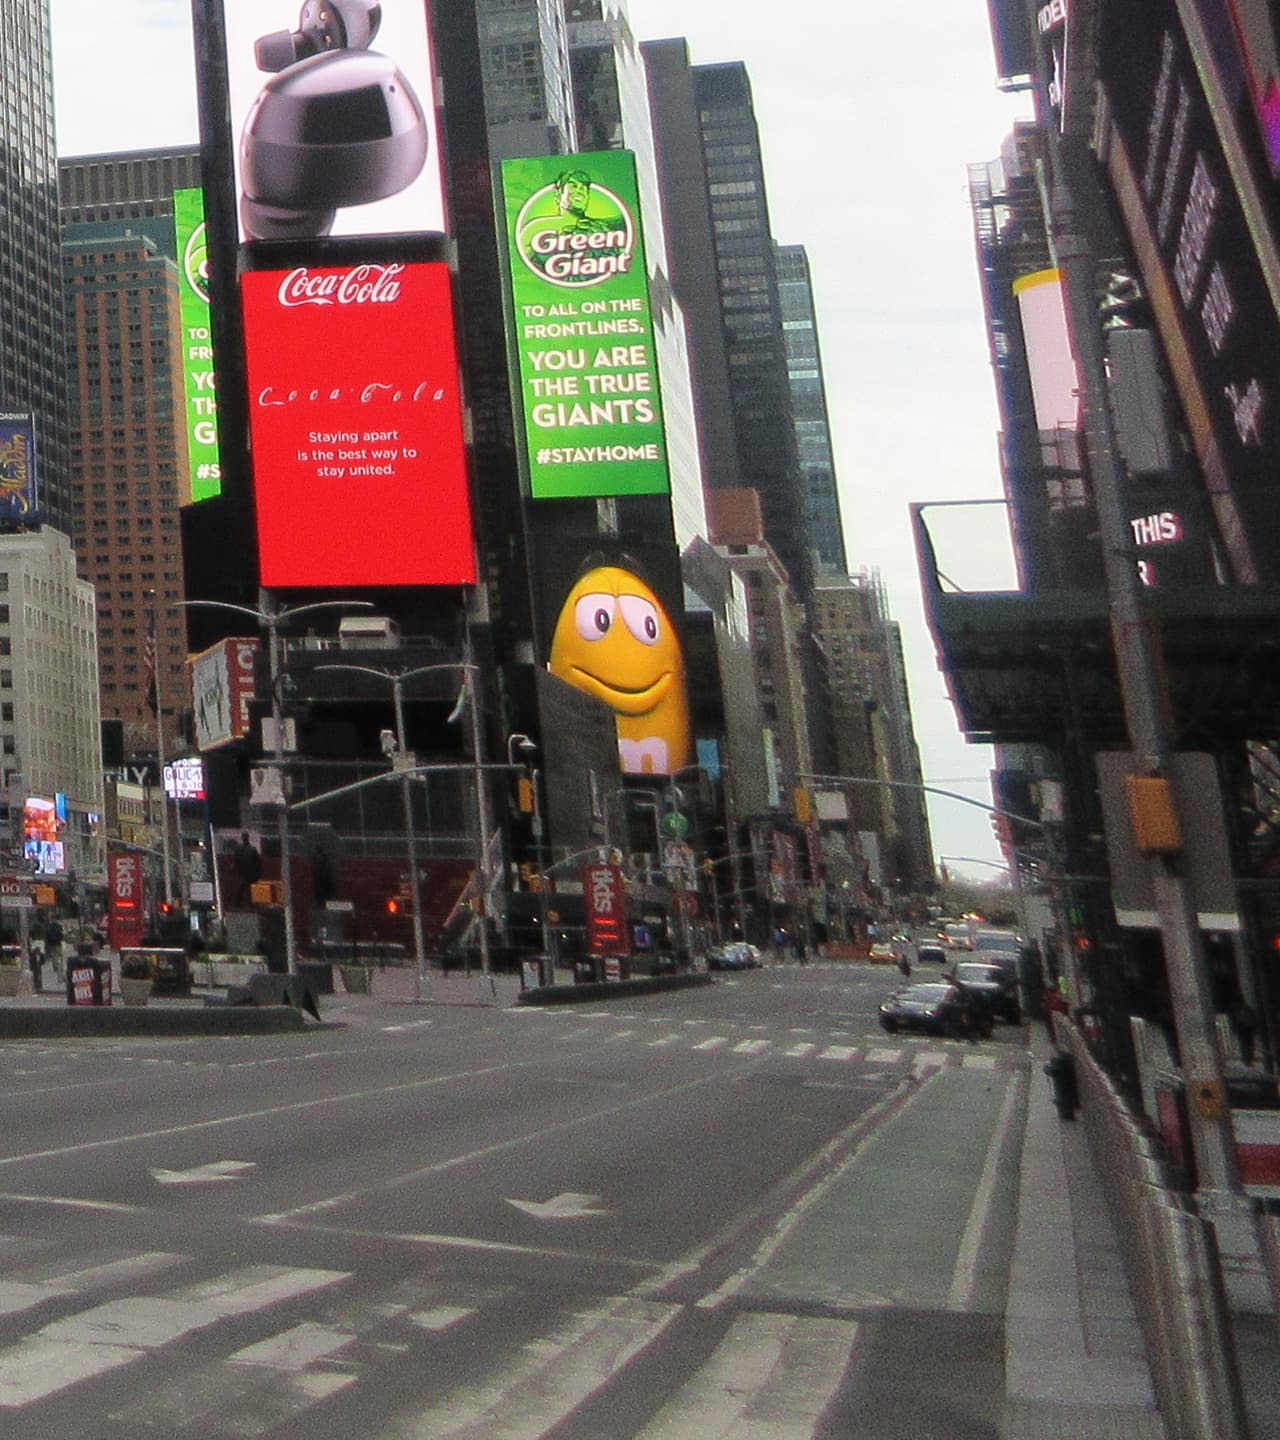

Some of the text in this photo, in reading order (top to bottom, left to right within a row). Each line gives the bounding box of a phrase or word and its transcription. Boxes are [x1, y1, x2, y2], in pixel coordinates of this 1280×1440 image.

[530, 229, 627, 254] Green
[544, 252, 631, 278] Giant
[278, 263, 406, 307] Coca-Cola
[522, 298, 642, 318] TO ALL ON THE
[524, 318, 645, 339] FRONTLINES,
[527, 345, 647, 371] YOU ARE
[528, 372, 651, 397] THE TRUE
[532, 398, 655, 428] GIANTS
[308, 430, 399, 444] Staying apart
[297, 447, 417, 461] is the best way to
[536, 443, 659, 464] #STAYHOME
[317, 464, 396, 479] stay united.
[1130, 511, 1178, 545] THIS
[116, 857, 136, 898] tkts
[591, 868, 616, 913] tkts
